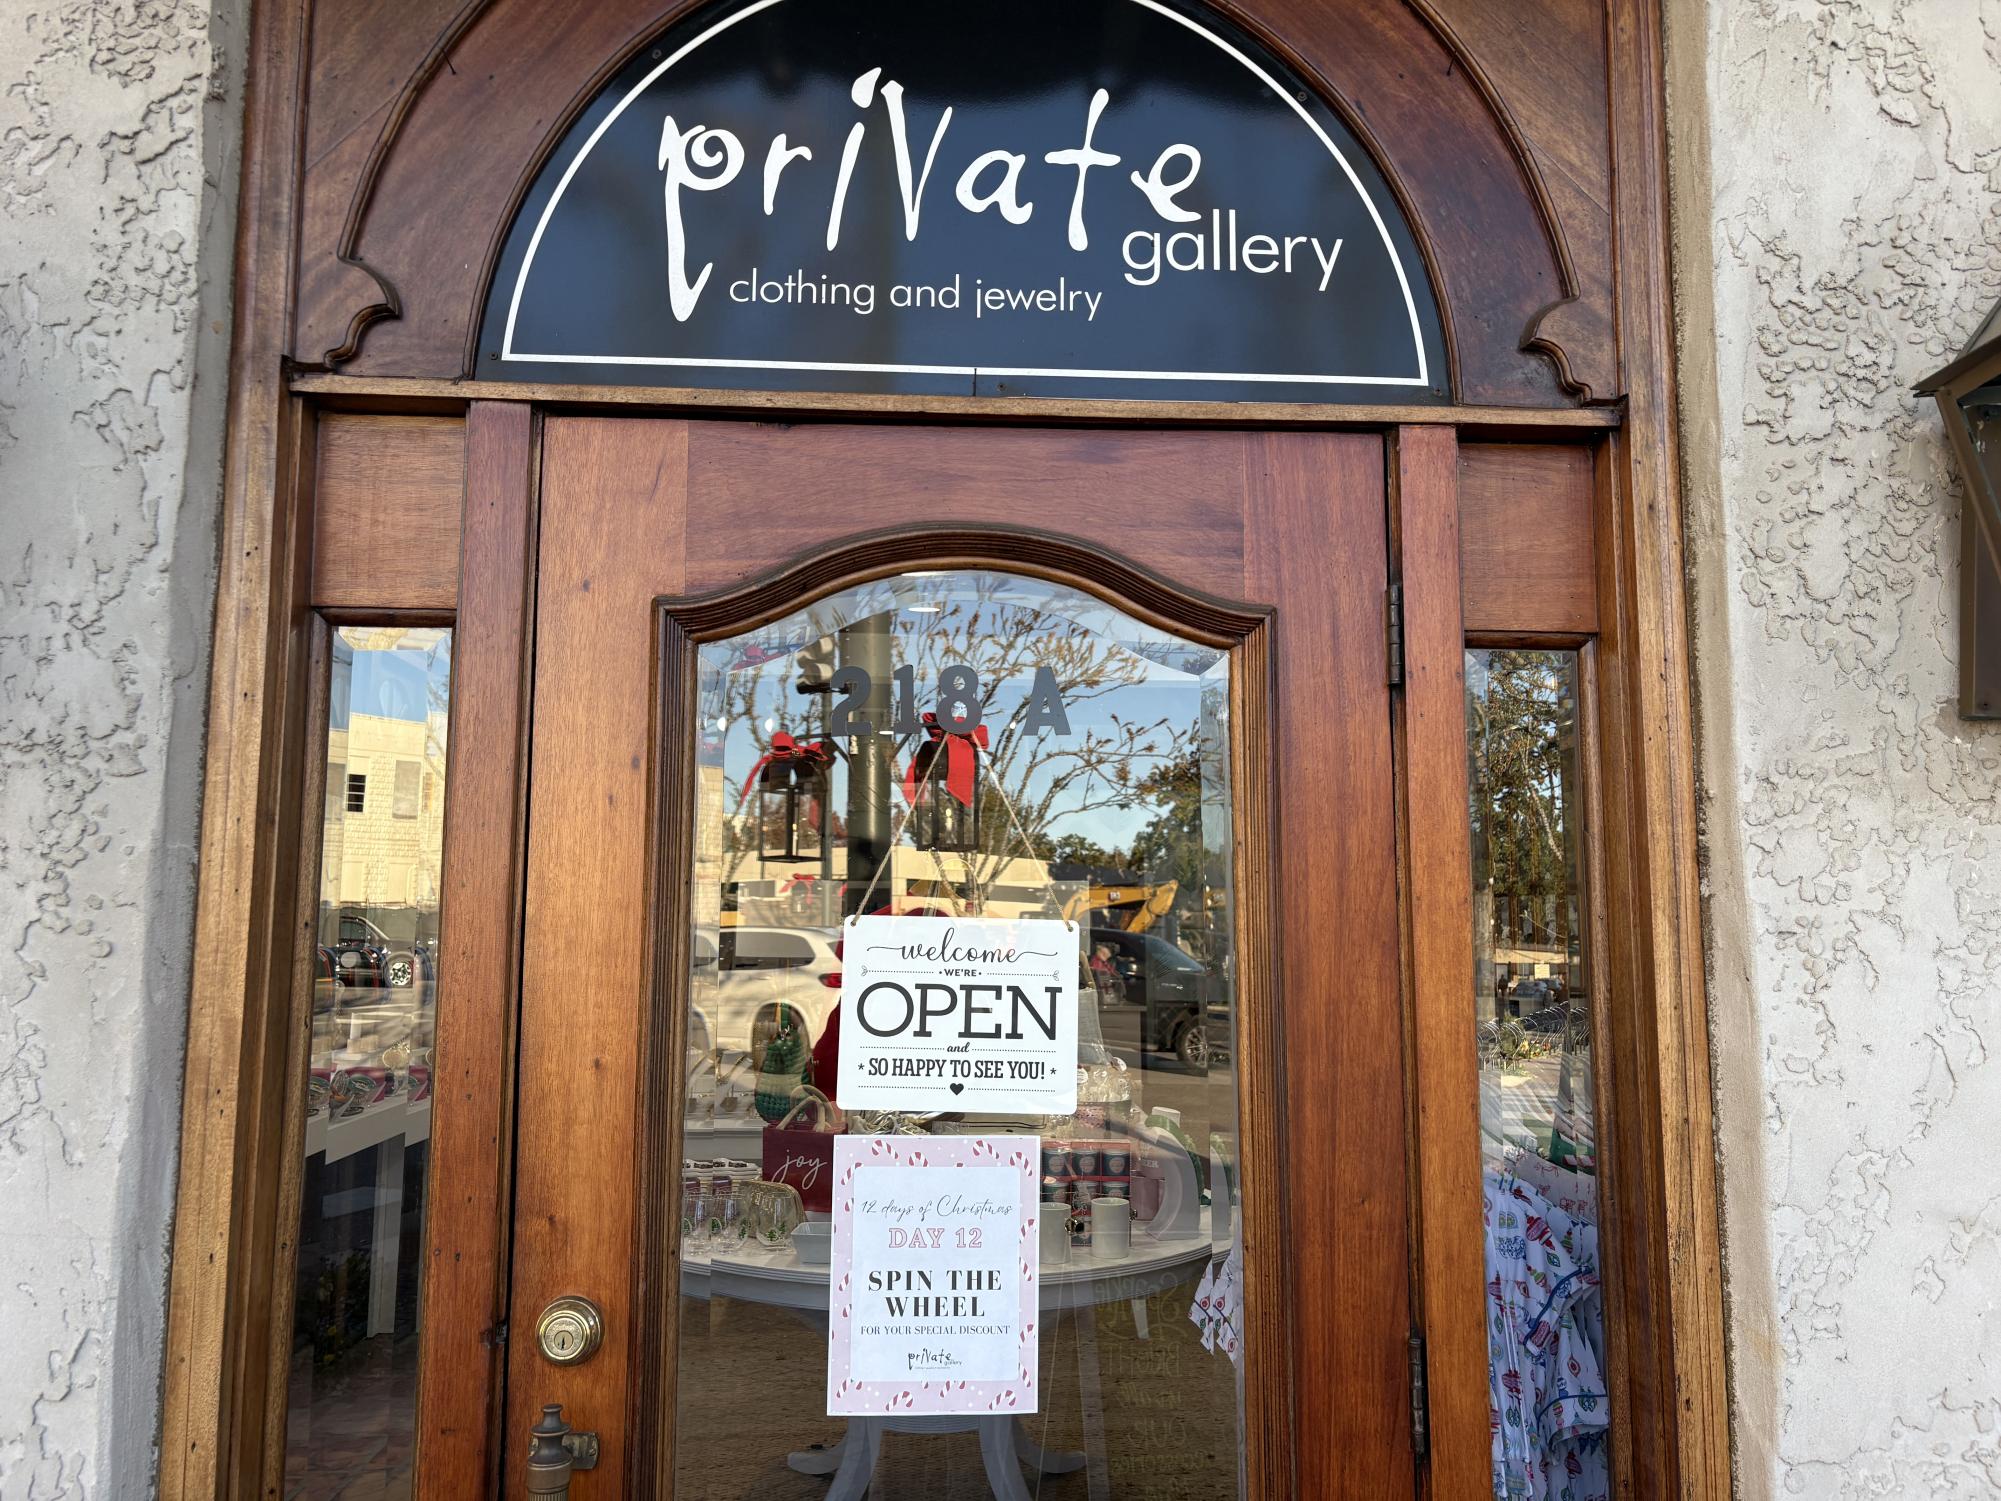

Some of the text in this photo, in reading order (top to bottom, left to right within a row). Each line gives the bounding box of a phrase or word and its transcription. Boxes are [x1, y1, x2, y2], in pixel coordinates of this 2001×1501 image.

[1121, 208, 1344, 291] gallery
[729, 267, 1103, 321] clothing and jewelry
[830, 664, 1072, 736] 218 A
[898, 927, 1025, 963] welcome
[944, 968, 977, 977] WE'RE
[856, 981, 1063, 1041] OPEN
[946, 1041, 971, 1053] and
[868, 1057, 1046, 1080] SO HAPPY TO SEE YOU!
[771, 1149, 828, 1190] joy
[861, 1194, 1013, 1222] 12 days of Christmas
[888, 1227, 982, 1249] DAY 12
[868, 1269, 1002, 1292] SPIN THE
[885, 1296, 985, 1317] WHEEL
[860, 1325, 1010, 1335] FOR YOUR SPECIAL DISCOUNT
